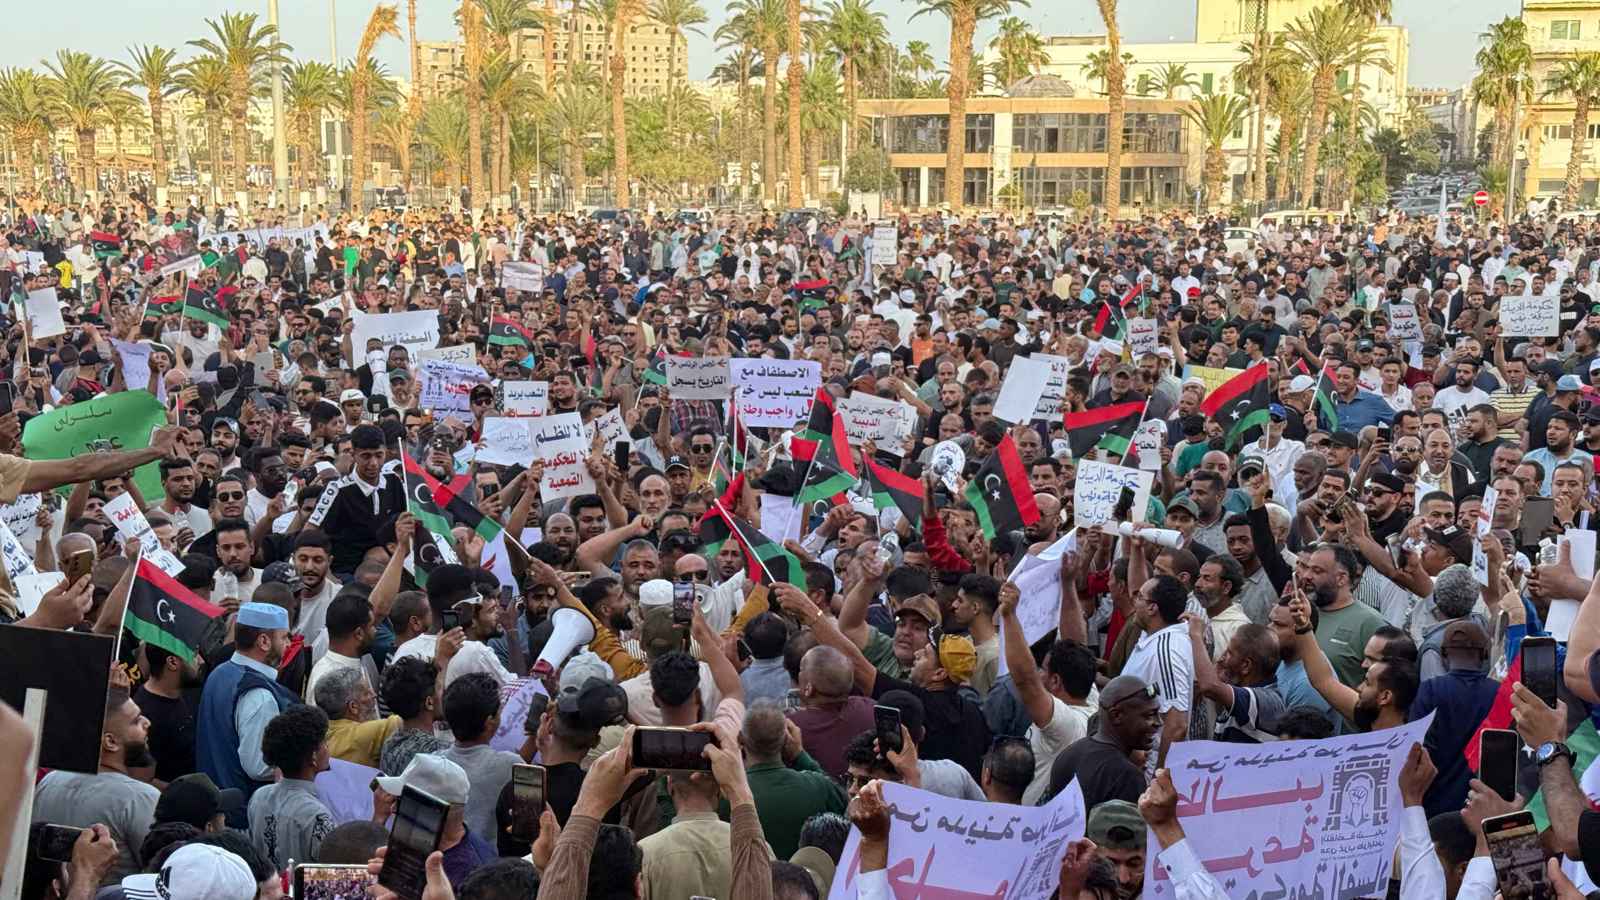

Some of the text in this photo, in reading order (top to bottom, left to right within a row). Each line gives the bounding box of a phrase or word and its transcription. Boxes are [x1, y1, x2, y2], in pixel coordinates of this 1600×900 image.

[740, 366, 810, 380] الاصطفاف مع
[698, 376, 727, 388] التاريخ
[758, 386, 781, 399] ليس
[784, 386, 814, 398] لشعب
[766, 405, 793, 419] واجب
[535, 424, 572, 447] للظلم
[573, 422, 583, 437] لا
[548, 473, 583, 489] القمعية
